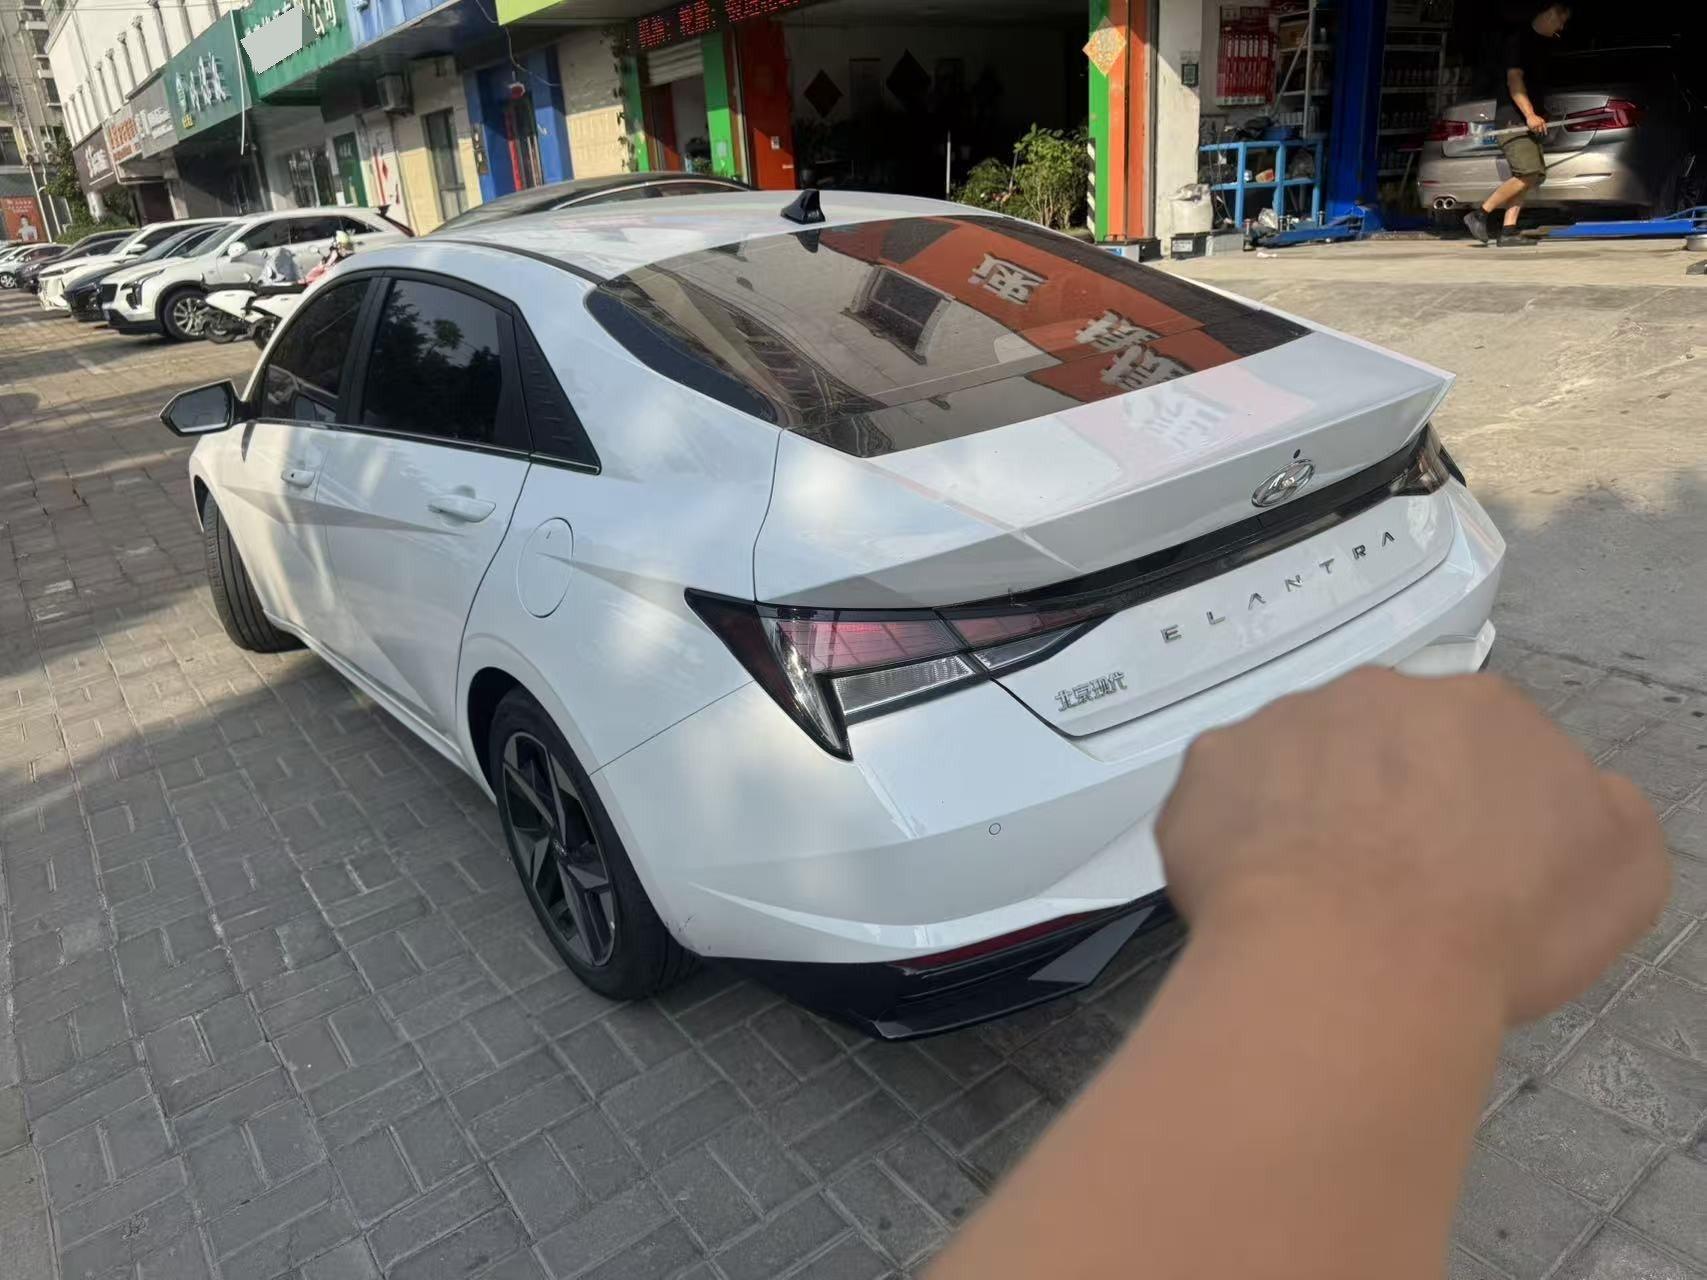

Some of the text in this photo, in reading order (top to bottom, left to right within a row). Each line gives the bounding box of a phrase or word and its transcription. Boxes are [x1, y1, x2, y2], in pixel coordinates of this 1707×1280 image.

[1161, 531, 1395, 643] ELANTRA
[1054, 671, 1128, 712] 北京现代
